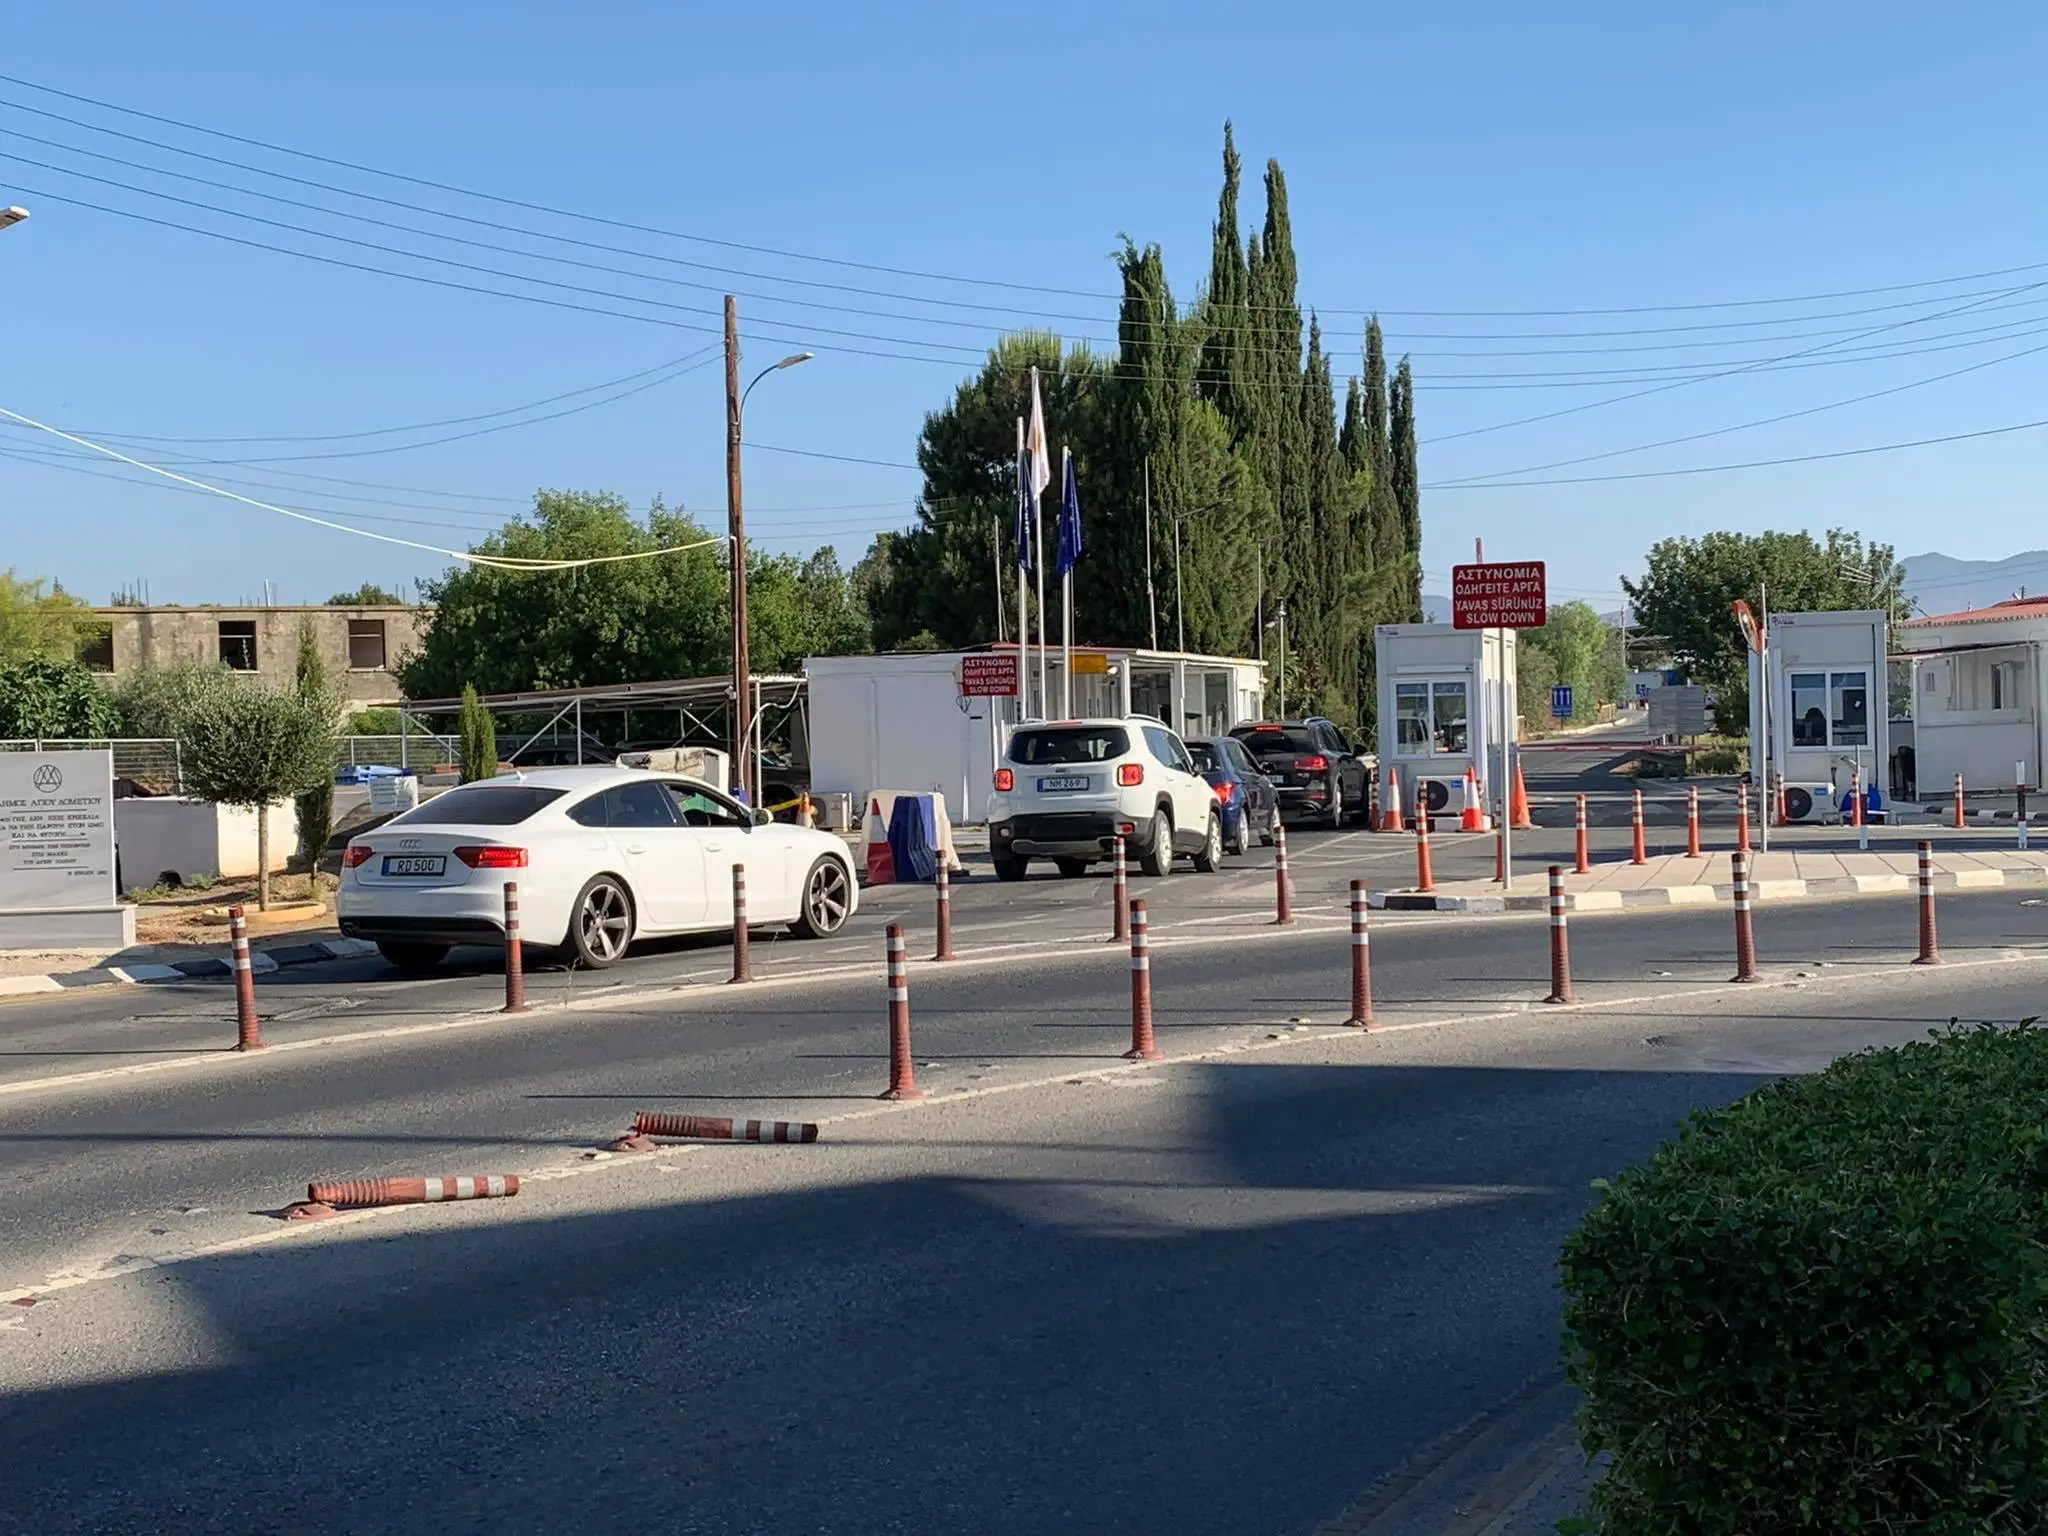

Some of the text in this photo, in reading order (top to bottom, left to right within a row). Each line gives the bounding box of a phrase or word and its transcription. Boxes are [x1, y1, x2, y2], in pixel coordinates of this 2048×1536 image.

[1456, 567, 1540, 580] ΑΣΤΥΝΟΜΙΑ
[1455, 582, 1541, 595] ΟΔΗΓΕΙΤΕ ΑΡΓΑ
[1466, 612, 1536, 624] SLOW DOWN
[965, 659, 1014, 667] ΑΣΤΥΝΟΜΙΑ
[1050, 779, 1080, 788] NM 269
[398, 859, 435, 872] RD 500
